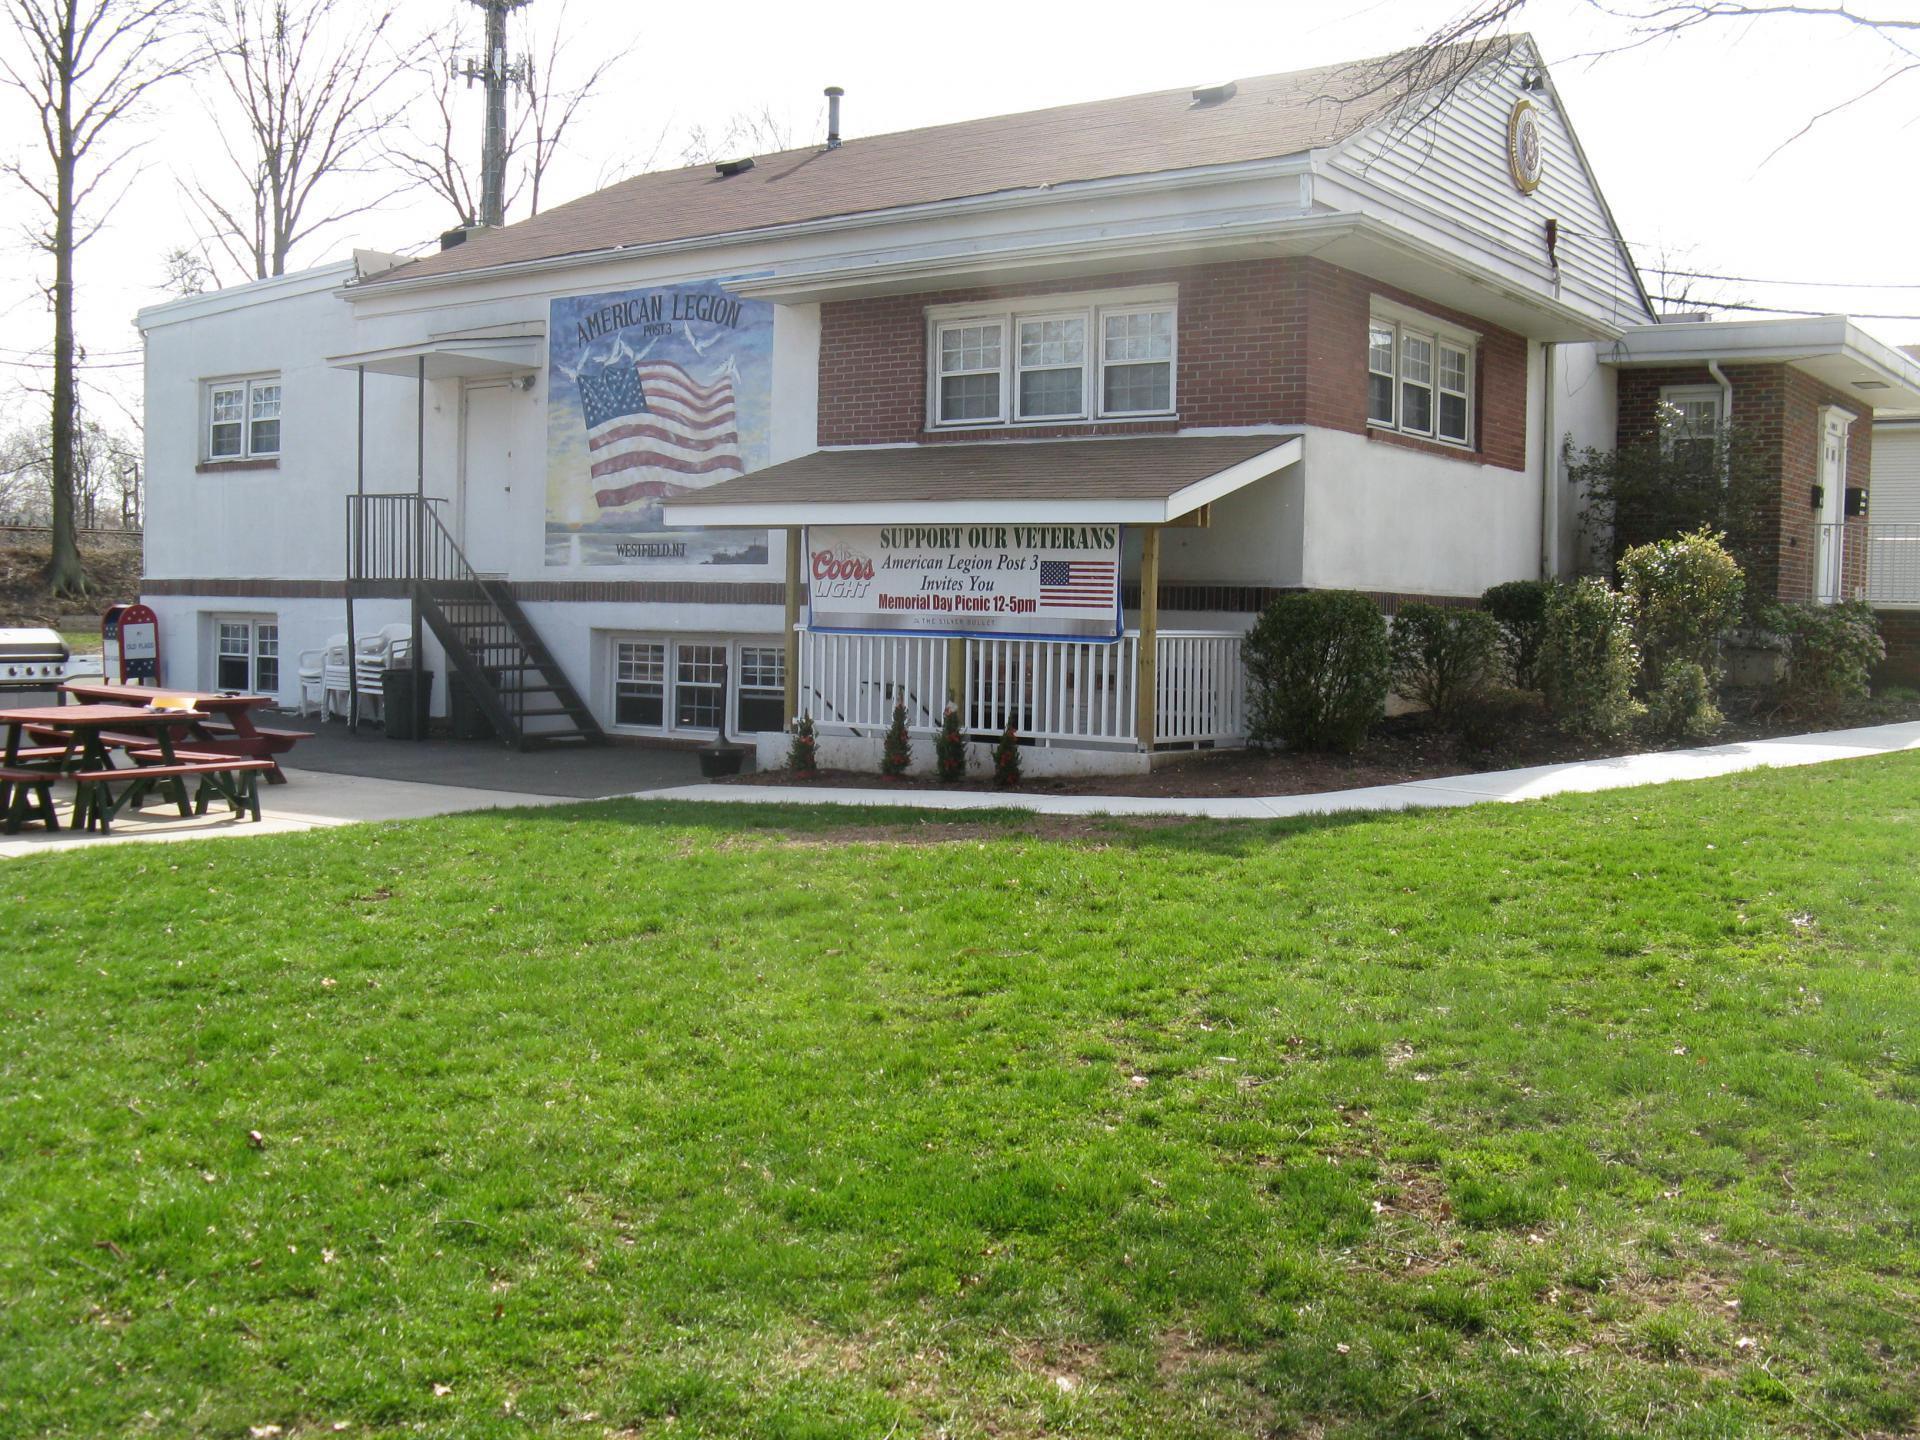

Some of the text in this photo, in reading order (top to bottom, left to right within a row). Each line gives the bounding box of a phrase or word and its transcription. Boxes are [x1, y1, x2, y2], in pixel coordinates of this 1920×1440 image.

[577, 293, 743, 348] AMERICAN LEGION
[643, 322, 672, 337] POST 3
[880, 527, 1115, 549] SUPPORT OUR VETERANS
[811, 549, 875, 580] Coors
[881, 554, 1039, 573] American Legion Post 3
[815, 580, 871, 598] LIGHT
[920, 575, 994, 592] Invites You
[878, 593, 1037, 614] Memorial Day Picnic 12-5pm
